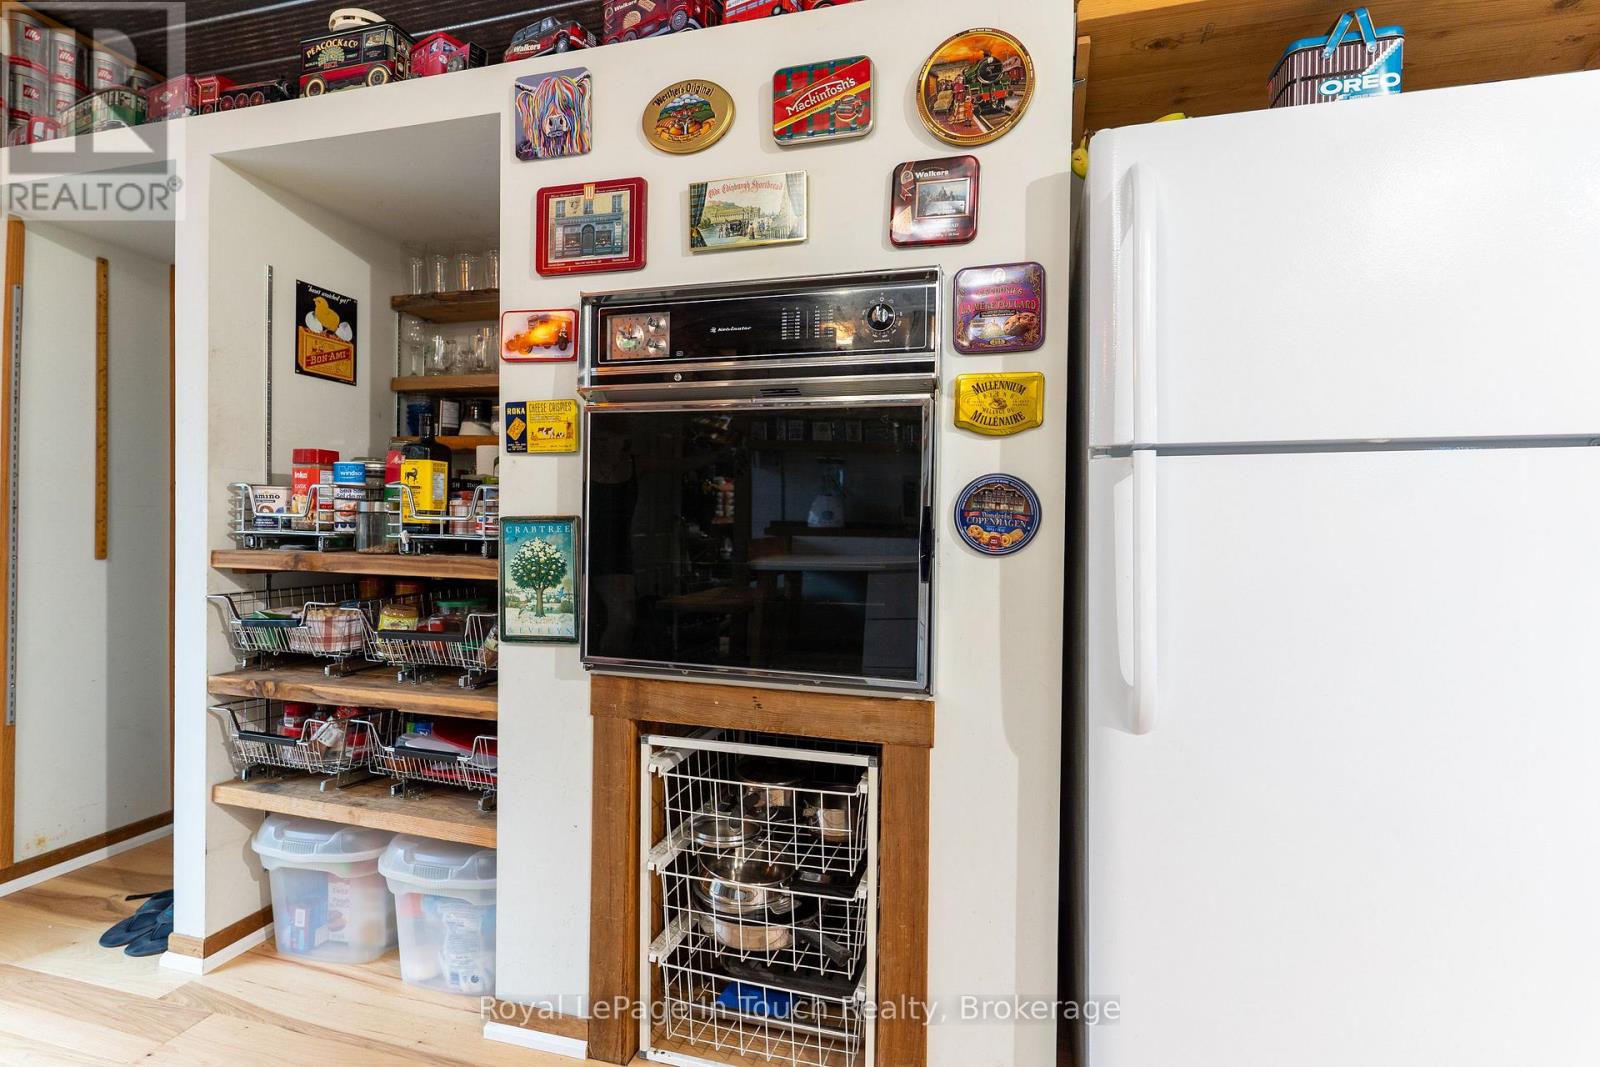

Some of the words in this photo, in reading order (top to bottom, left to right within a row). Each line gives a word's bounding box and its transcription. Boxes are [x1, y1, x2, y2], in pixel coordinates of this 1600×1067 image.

[306, 38, 344, 59] PEACOCK
[513, 42, 542, 53] Walkers
[1320, 72, 1401, 96] OREO
[652, 85, 685, 107] Werther's
[685, 82, 715, 97] Original
[785, 77, 856, 116] Mackintosh's
[915, 170, 950, 179] Walkers
[971, 380, 1027, 396] MILLENNIUM
[970, 410, 1026, 427] MILLÉNAIRE
[505, 525, 571, 534] CRABTREE
[966, 516, 1027, 528] COPENHAGEN
